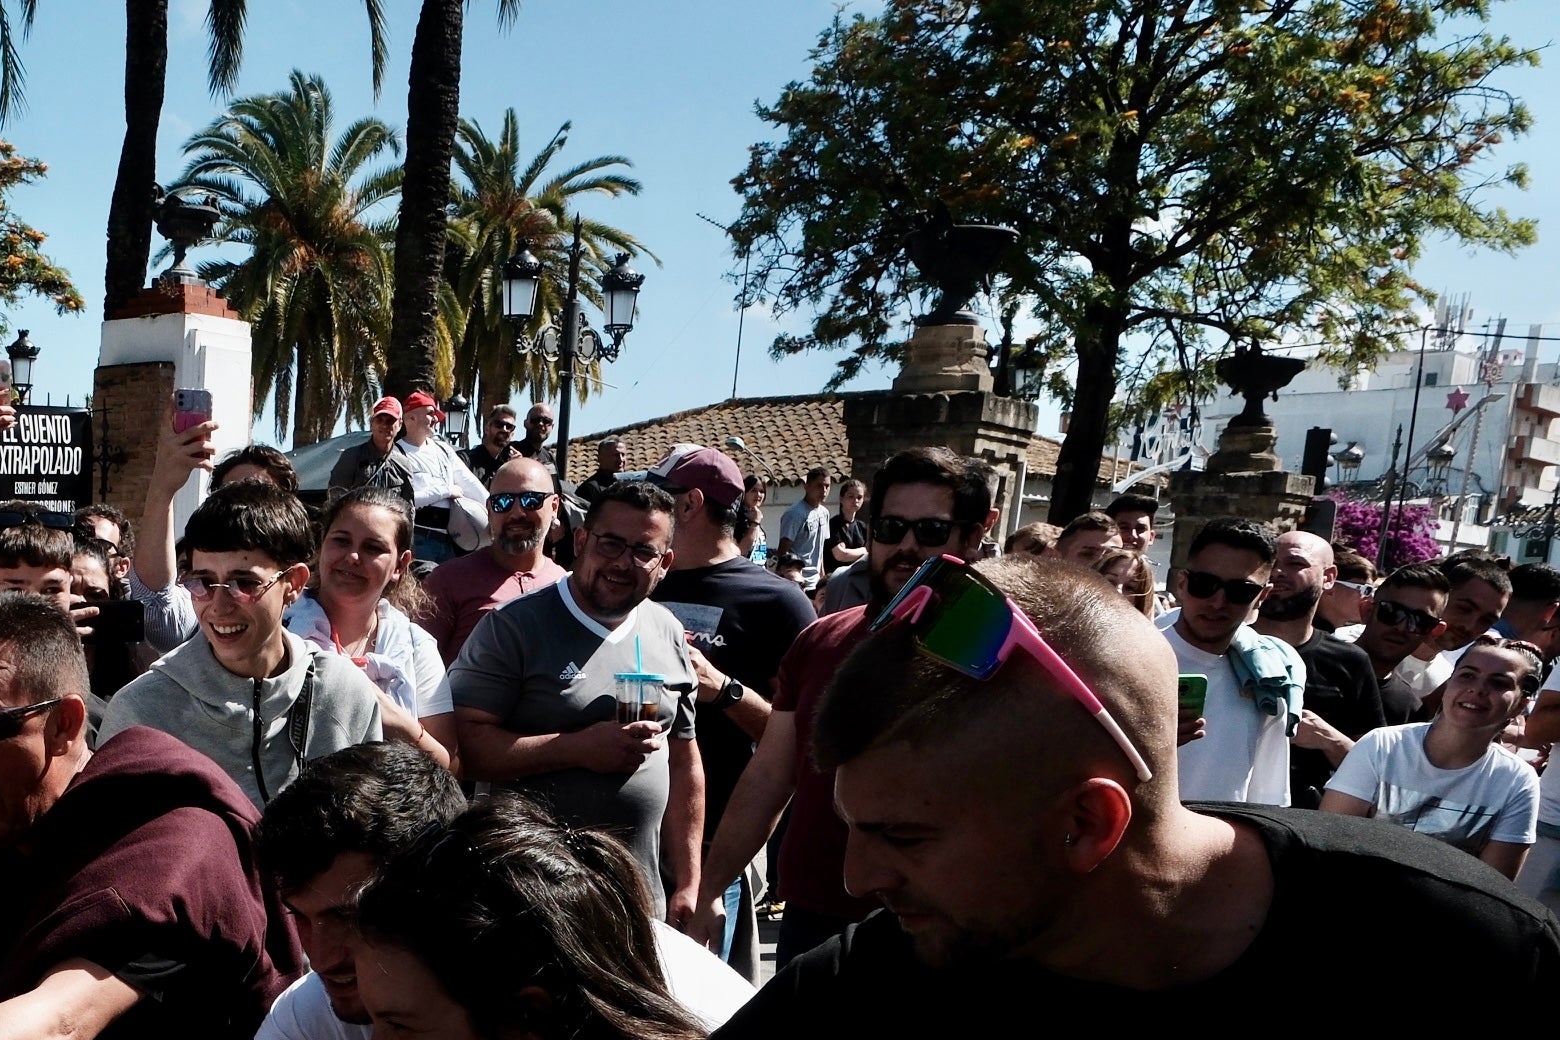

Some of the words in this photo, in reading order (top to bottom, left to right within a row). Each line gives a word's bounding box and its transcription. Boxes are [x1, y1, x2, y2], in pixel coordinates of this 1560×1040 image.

[20, 413, 72, 445] CUENTO
[14, 481, 37, 495] ESTHER
[37, 478, 59, 495] GÓMEZ
